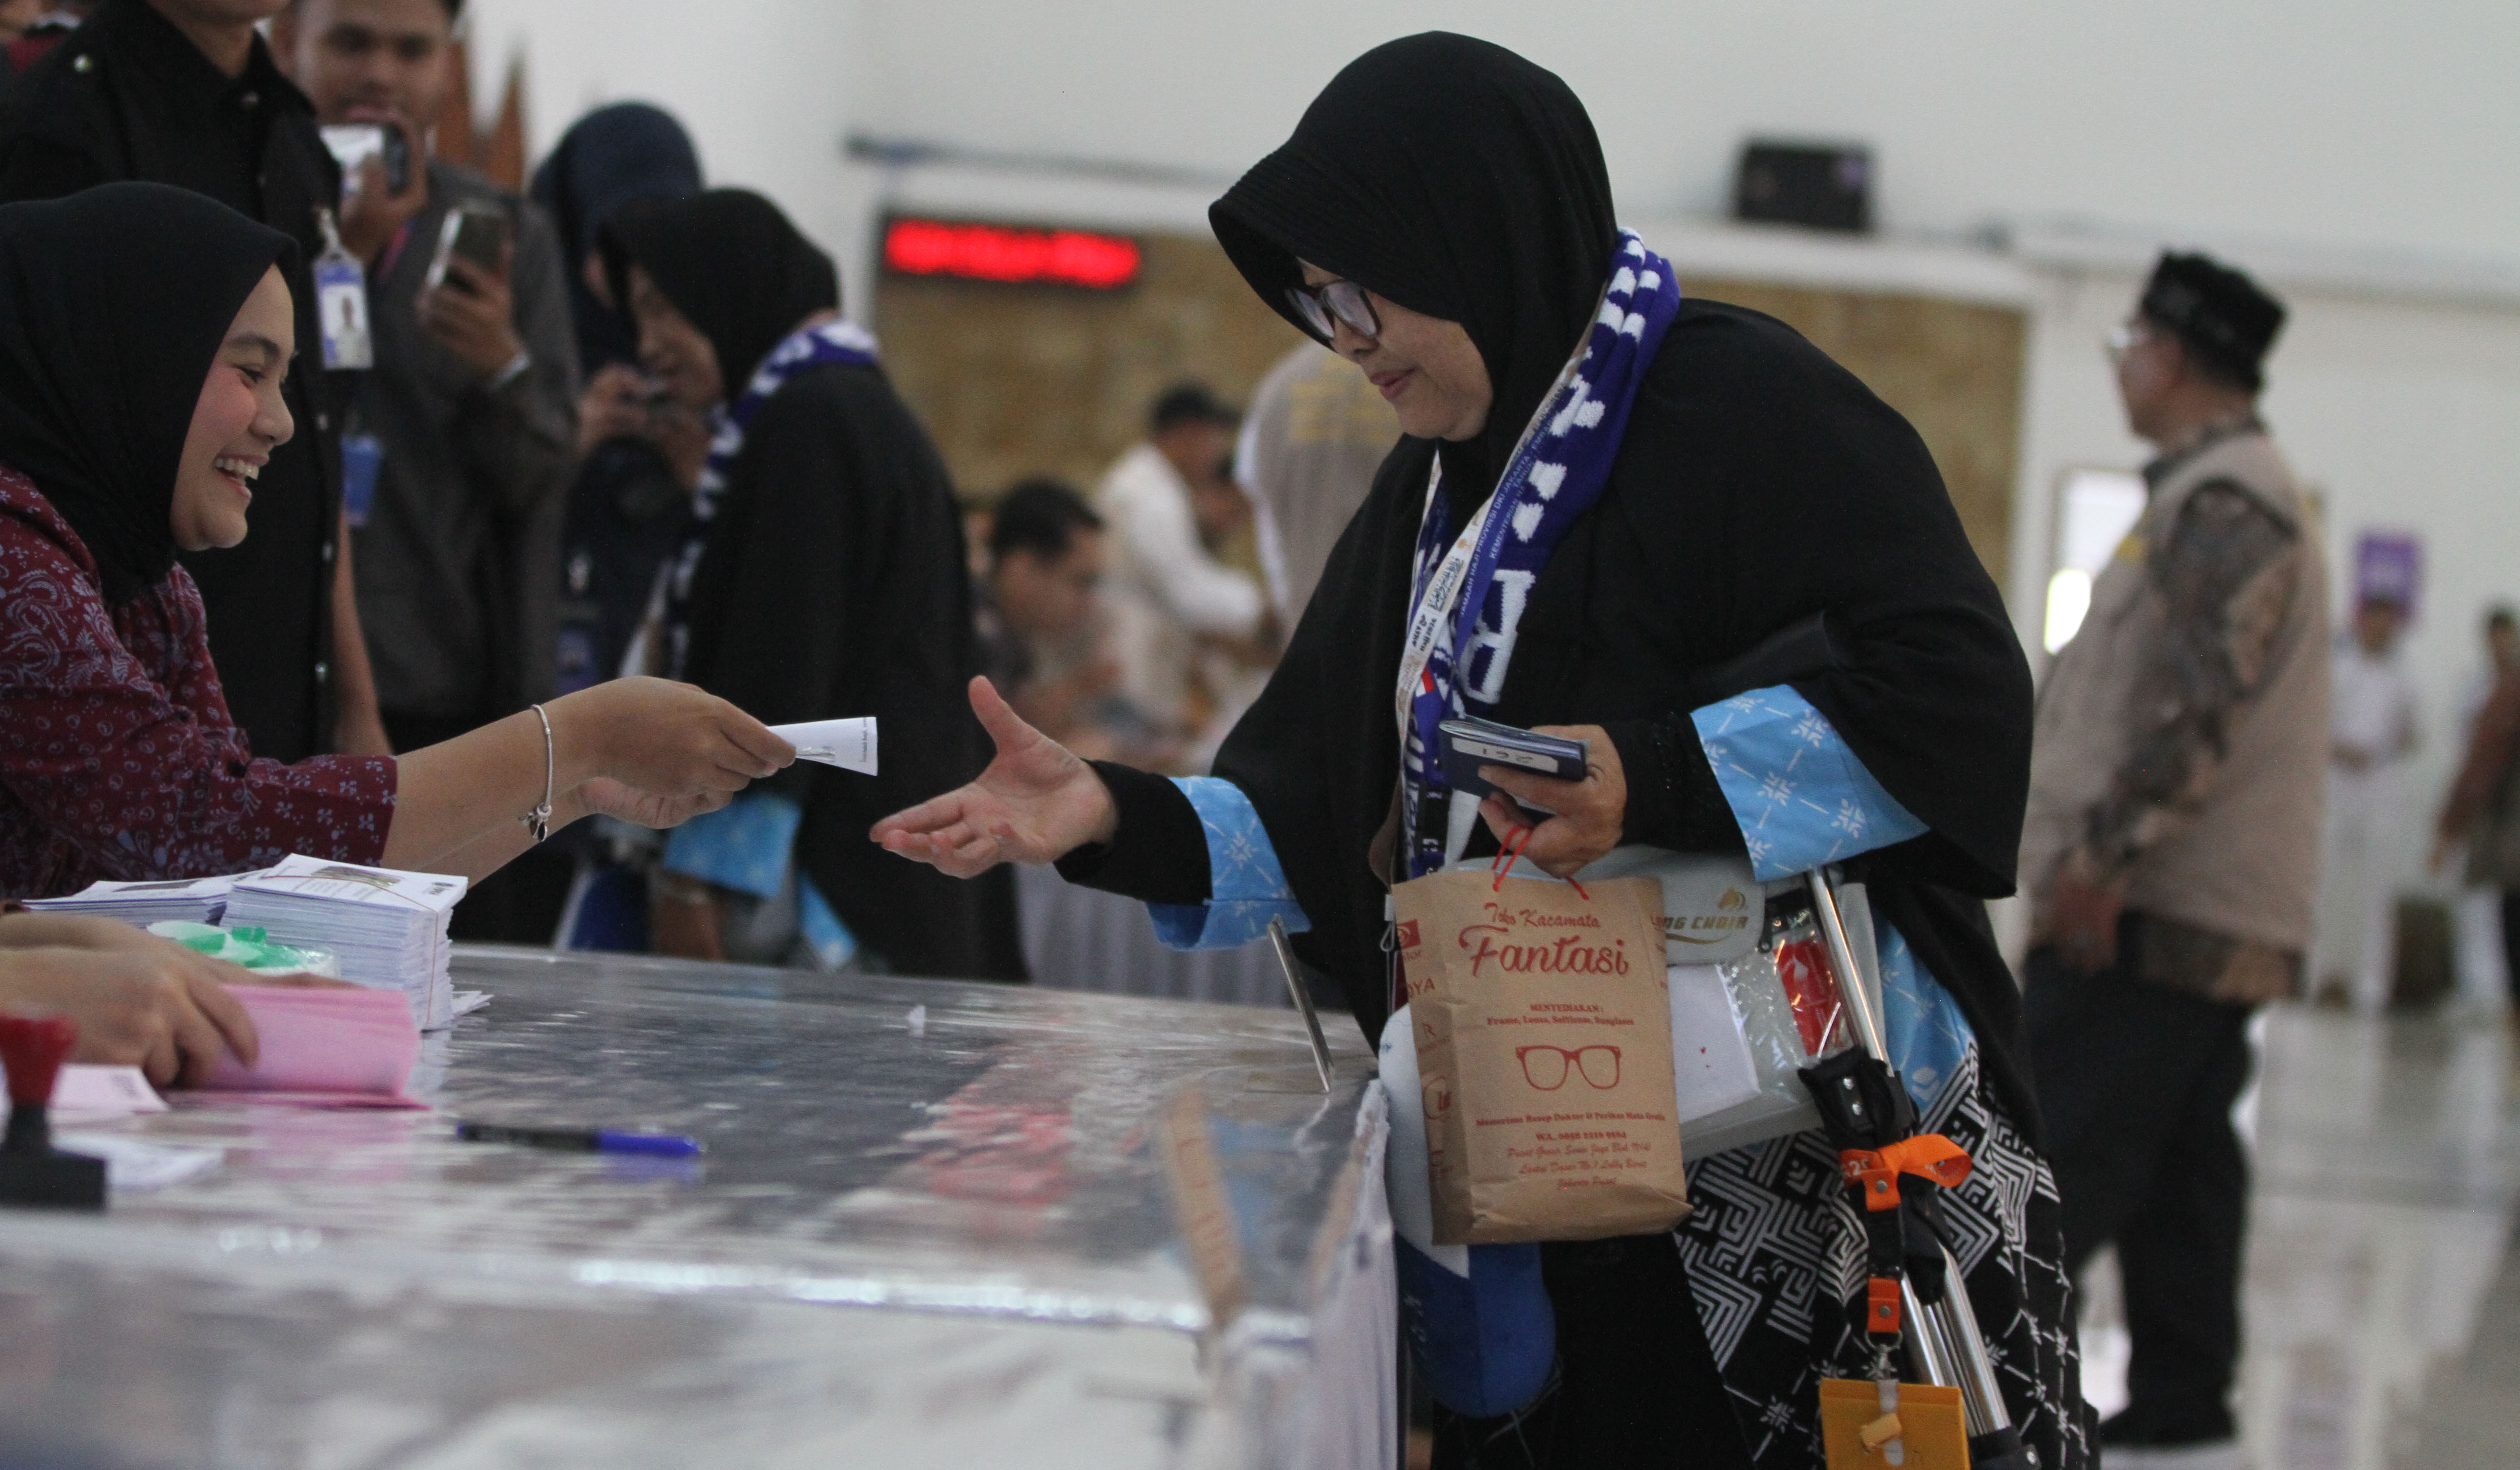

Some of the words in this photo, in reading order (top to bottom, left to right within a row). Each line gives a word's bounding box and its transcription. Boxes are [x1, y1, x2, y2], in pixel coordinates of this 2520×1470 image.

[1470, 554, 1481, 577] HAJI
[1476, 509, 1498, 553] PROVINSI
[1493, 492, 1505, 509] DKI
[1502, 454, 1531, 493] JAKARTA
[1519, 908, 1600, 928] Kacamata
[1459, 925, 1628, 978] Fantasi
